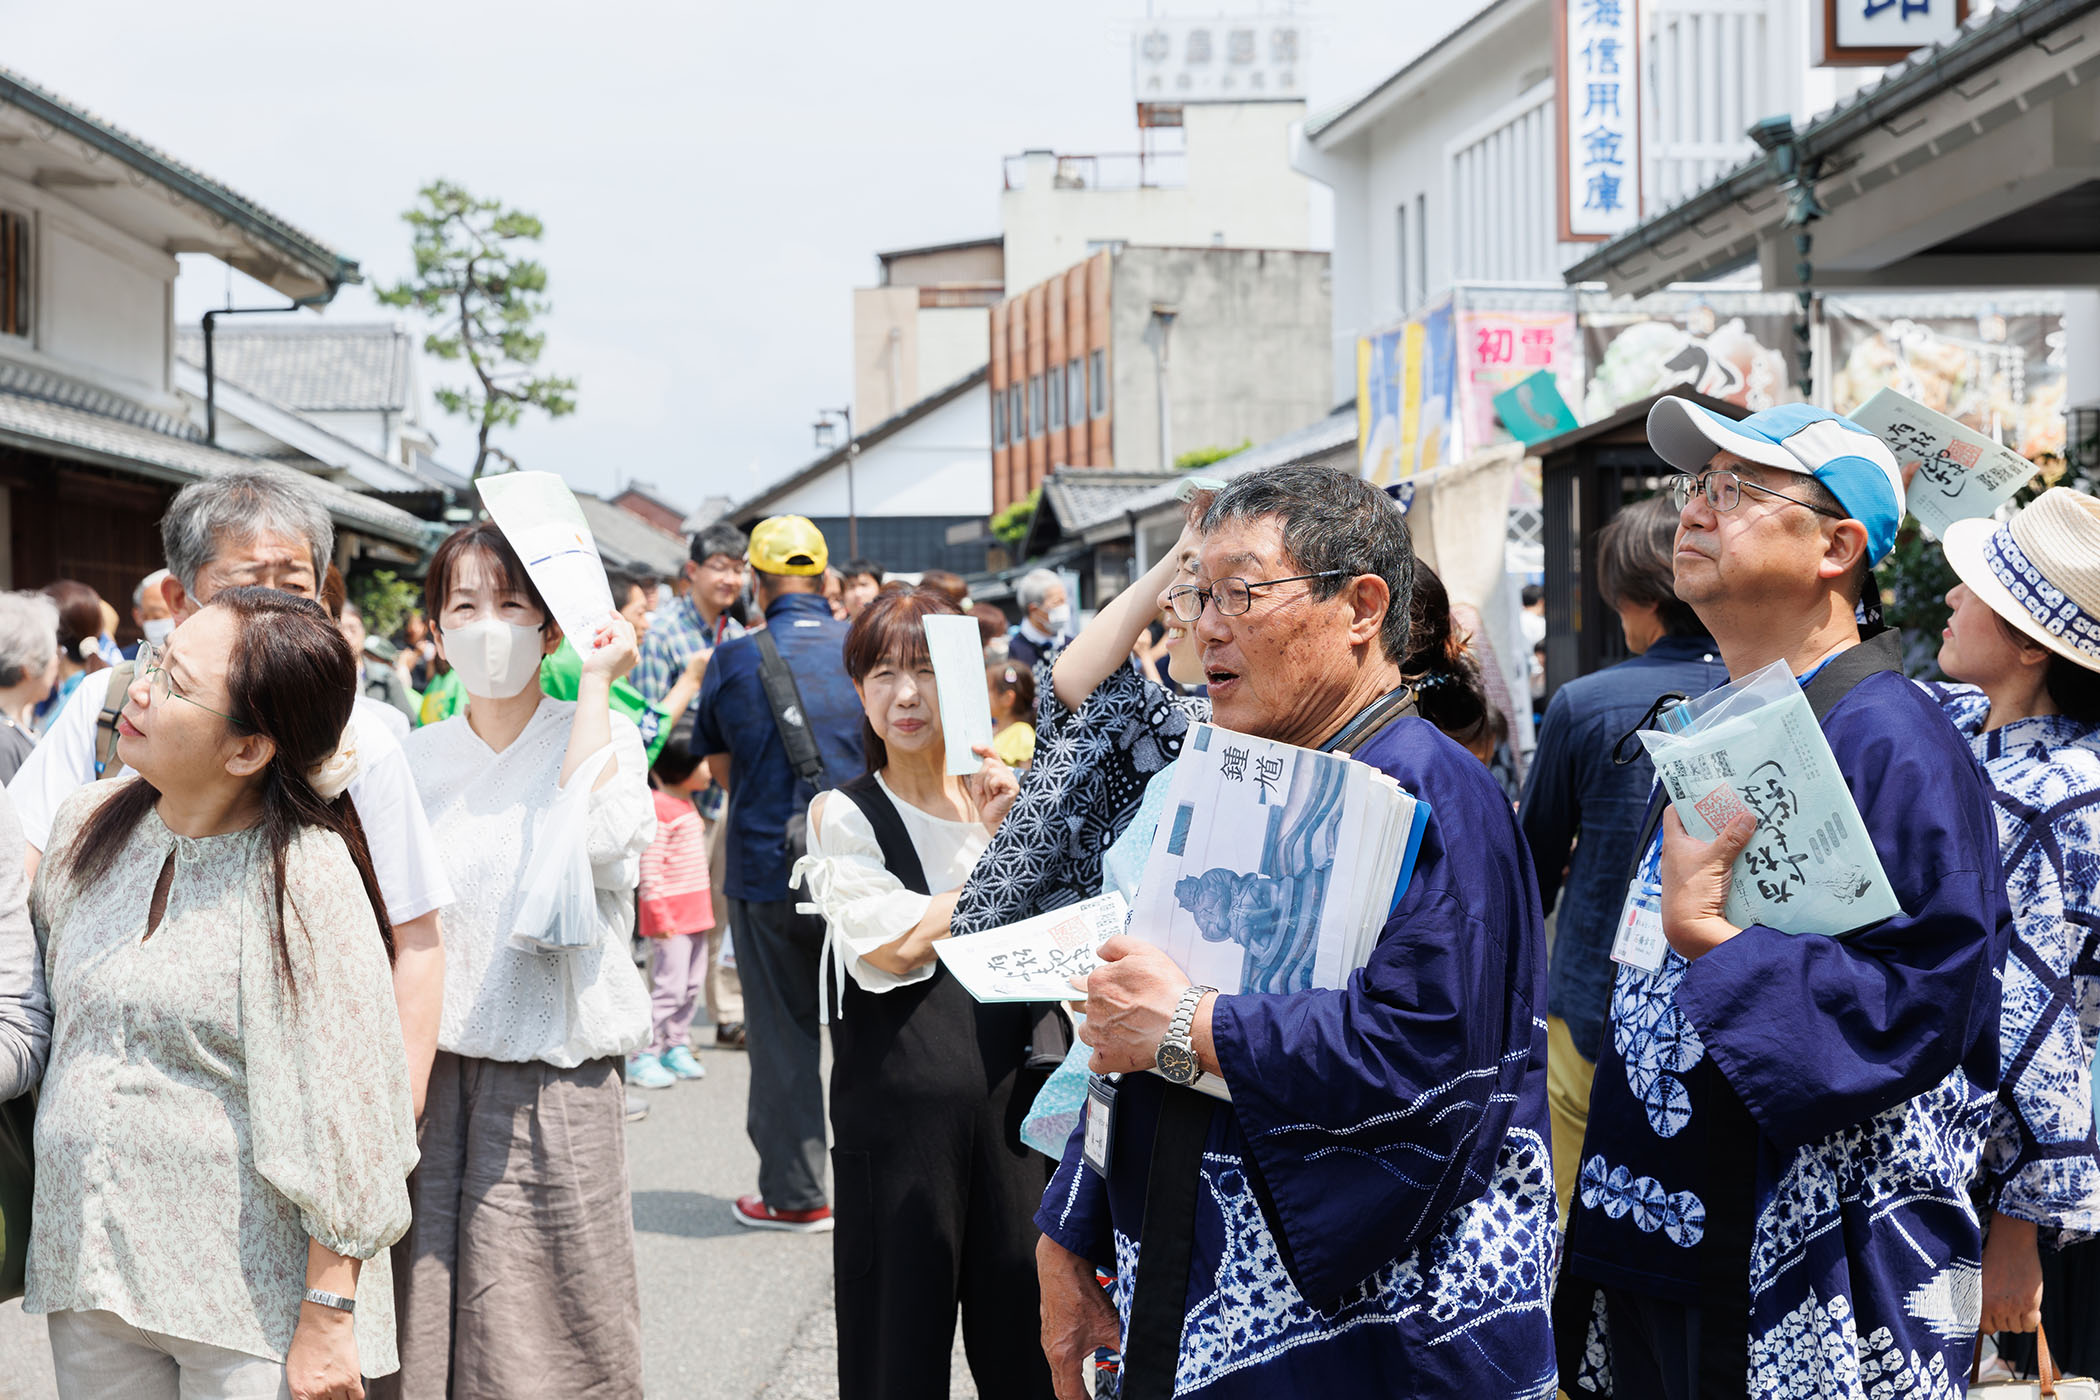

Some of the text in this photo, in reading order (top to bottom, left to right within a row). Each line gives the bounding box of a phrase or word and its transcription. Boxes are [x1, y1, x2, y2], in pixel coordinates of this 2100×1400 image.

[1581, 0, 1624, 214] 海信用金庫
[1477, 328, 1554, 365] 初雪
